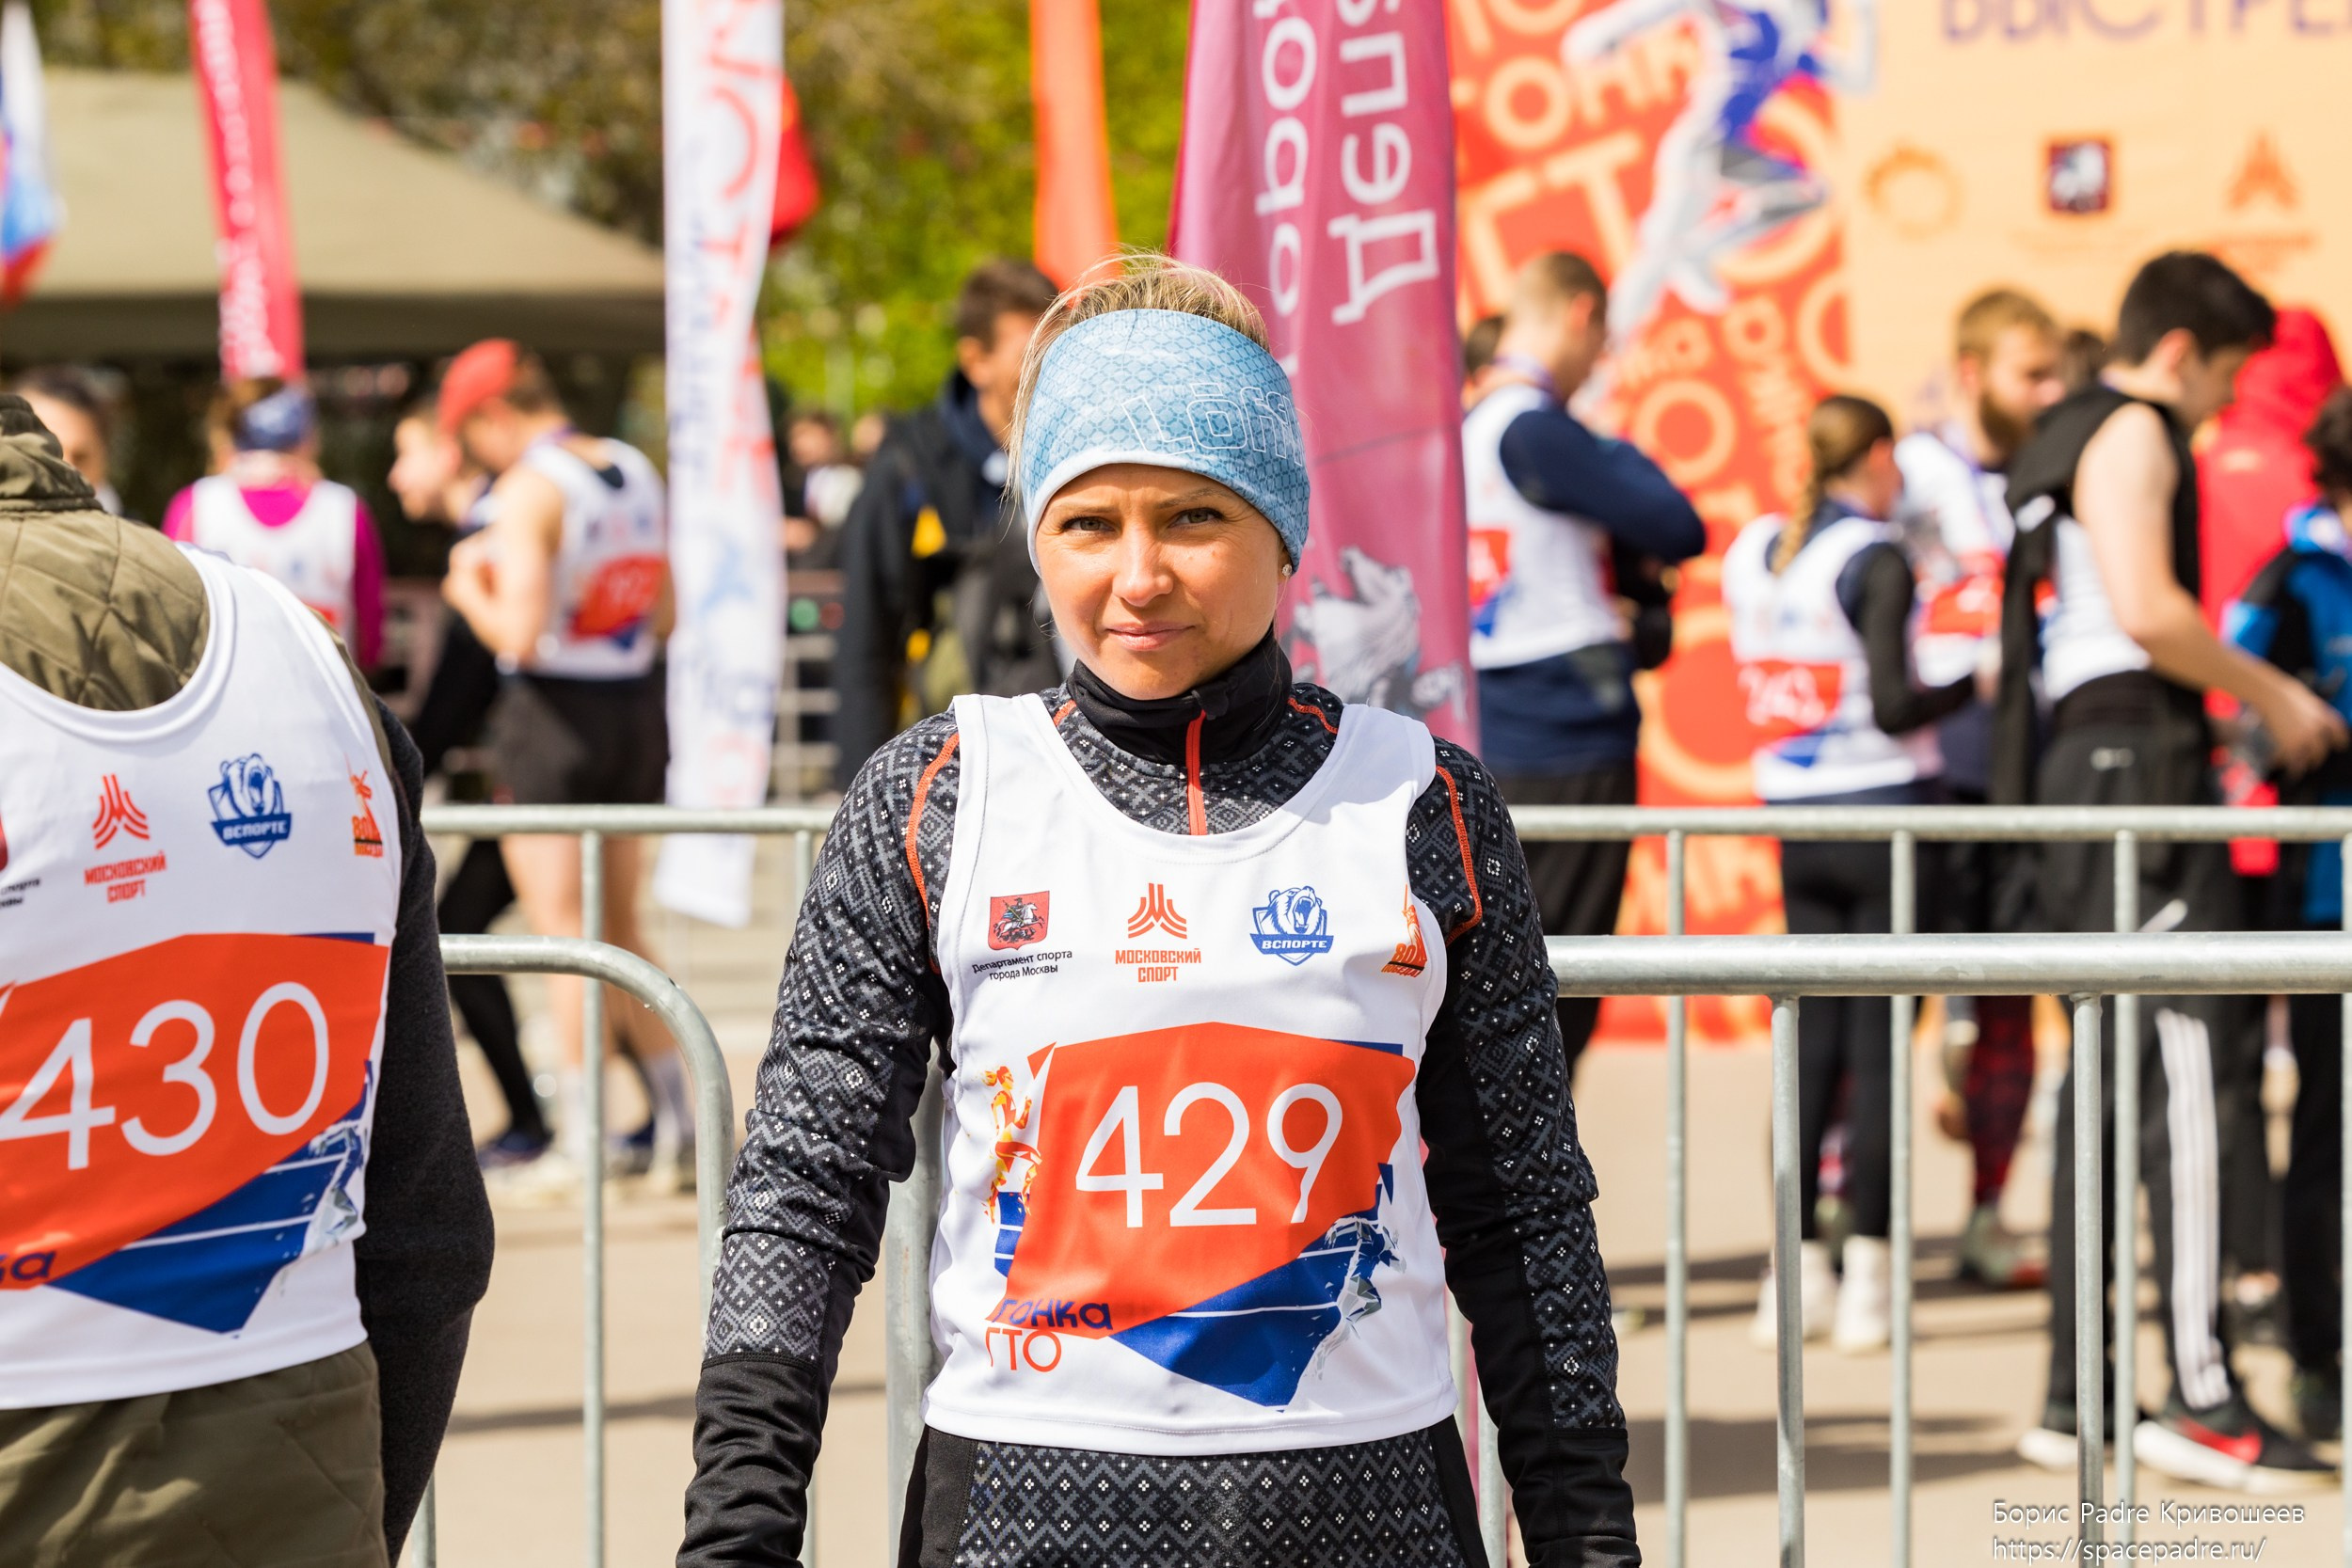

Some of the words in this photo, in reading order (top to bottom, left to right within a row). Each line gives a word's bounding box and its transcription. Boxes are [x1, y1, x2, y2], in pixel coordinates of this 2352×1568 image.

[222, 819, 289, 841] ВСПОРТЕ
[84, 850, 167, 886] МОСКОВСКИЙ
[106, 879, 148, 904] СПОРТ
[1115, 947, 1201, 965] МОСКОВСКИЙ
[1262, 940, 1327, 950] ВСПОРТЕ
[971, 955, 1034, 974] Департамент
[1037, 950, 1073, 963] спорта
[989, 969, 1021, 982] города
[1022, 964, 1058, 977] Москвы
[1137, 966, 1179, 983] СПОРТ
[0, 981, 329, 1170] 430
[1075, 1082, 1343, 1228] 429
[985, 1325, 1062, 1373] ГТО
